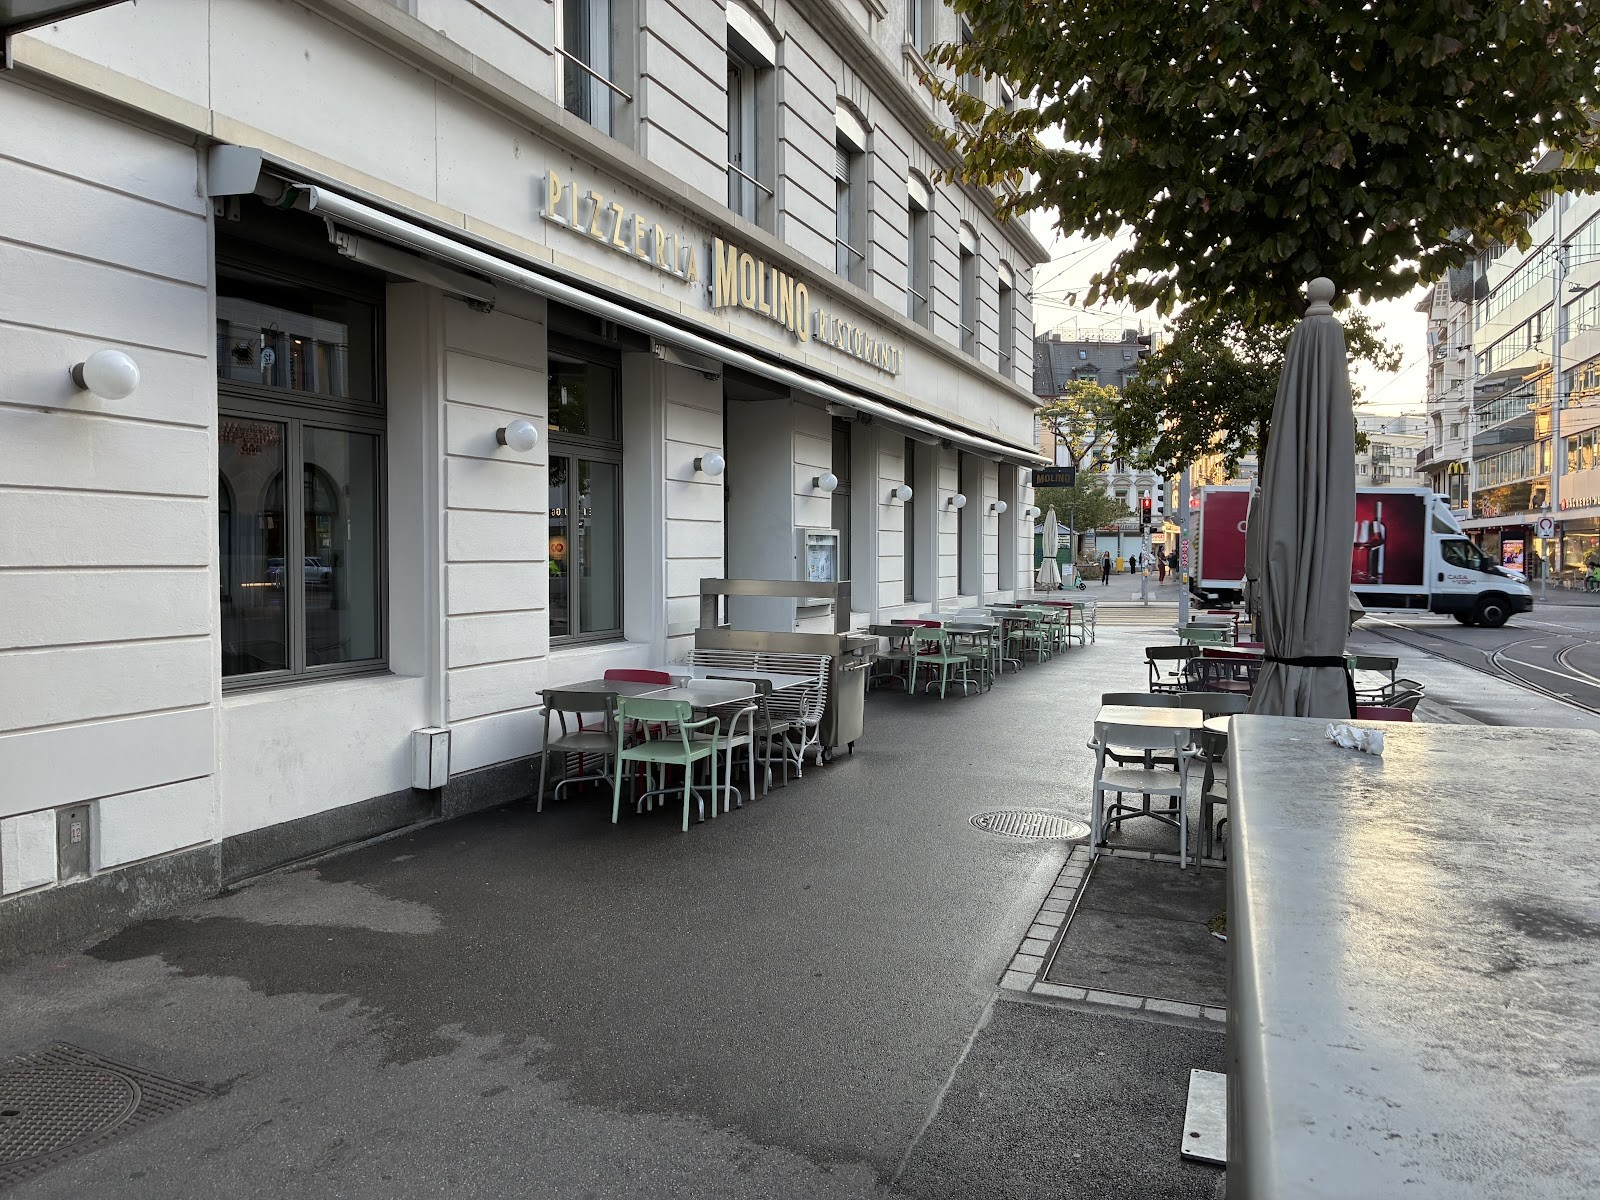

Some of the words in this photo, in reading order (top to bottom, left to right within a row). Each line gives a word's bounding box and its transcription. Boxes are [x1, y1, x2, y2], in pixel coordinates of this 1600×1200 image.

[547, 168, 698, 282] PIZZERIA
[713, 236, 810, 343] MOLINO
[817, 306, 904, 376] RISTORANTE
[1036, 473, 1070, 484] MOLINO
